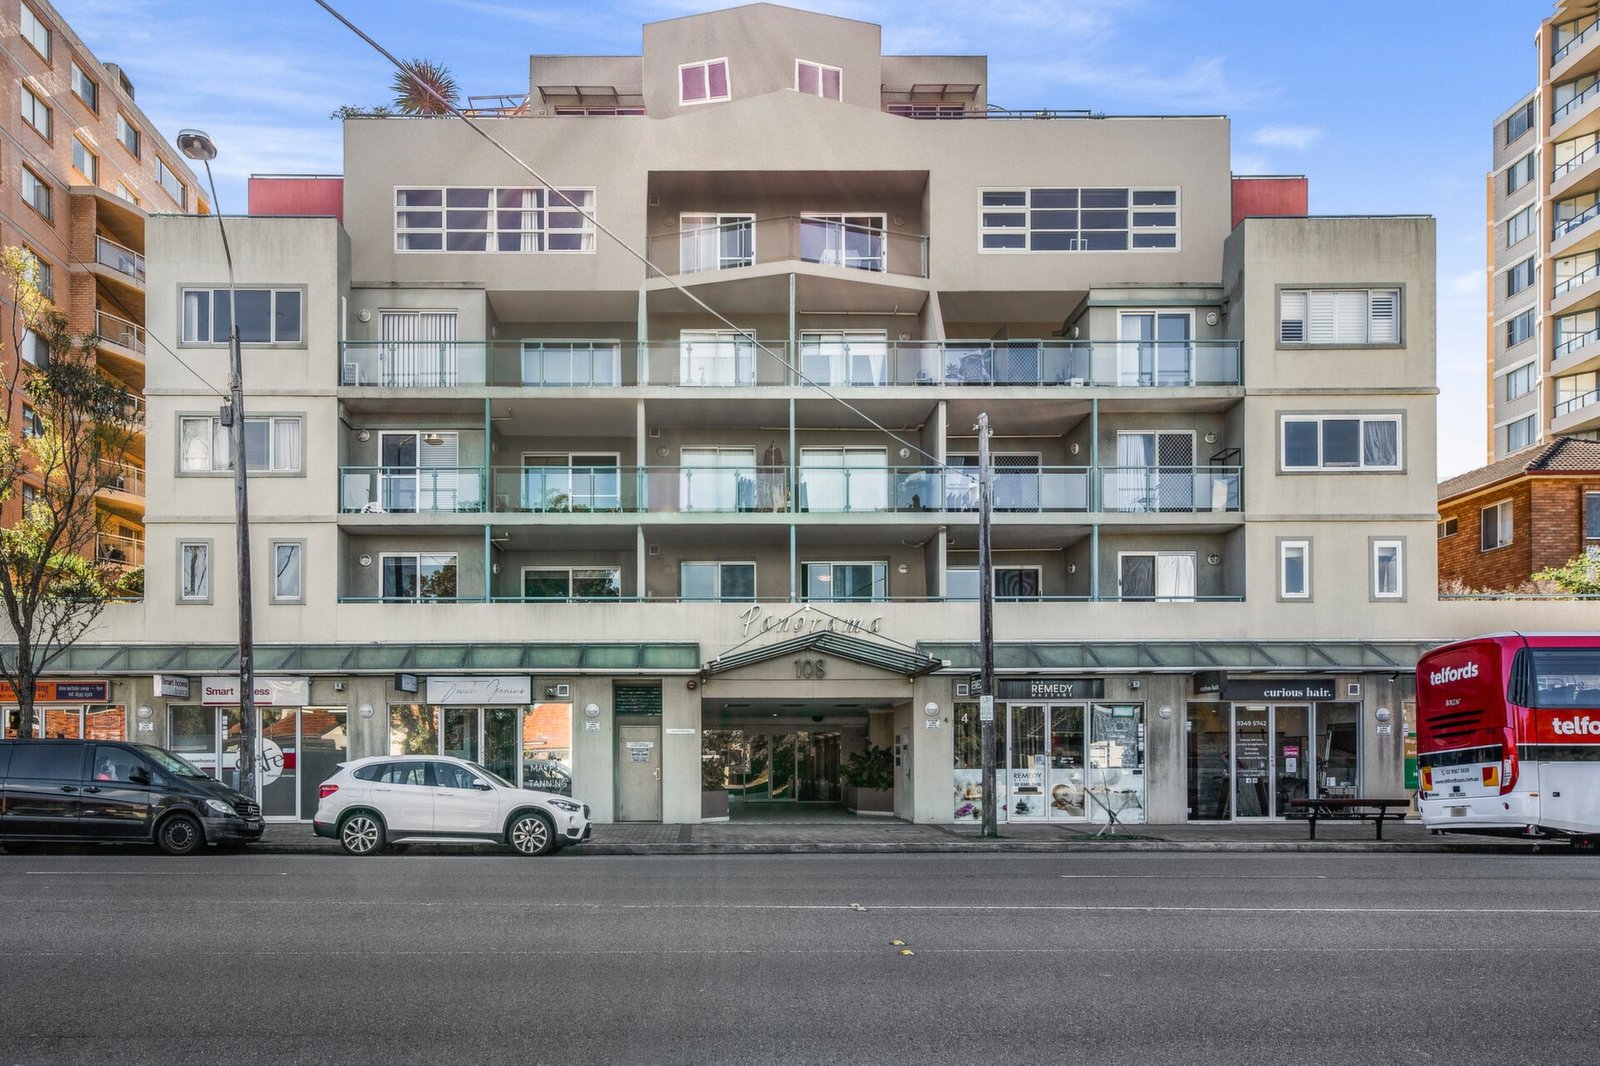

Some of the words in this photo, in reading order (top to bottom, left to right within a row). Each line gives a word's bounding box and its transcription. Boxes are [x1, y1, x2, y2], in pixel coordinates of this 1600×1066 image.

[740, 605, 882, 637] Panorama
[794, 660, 826, 678] 108
[1430, 662, 1479, 686] telfords
[205, 687, 234, 696] Smart
[1031, 684, 1074, 693] REMEDY
[1263, 687, 1303, 697] curious
[1306, 687, 1332, 697] hair.
[961, 713, 969, 723] 4
[529, 779, 568, 788] TANNING
